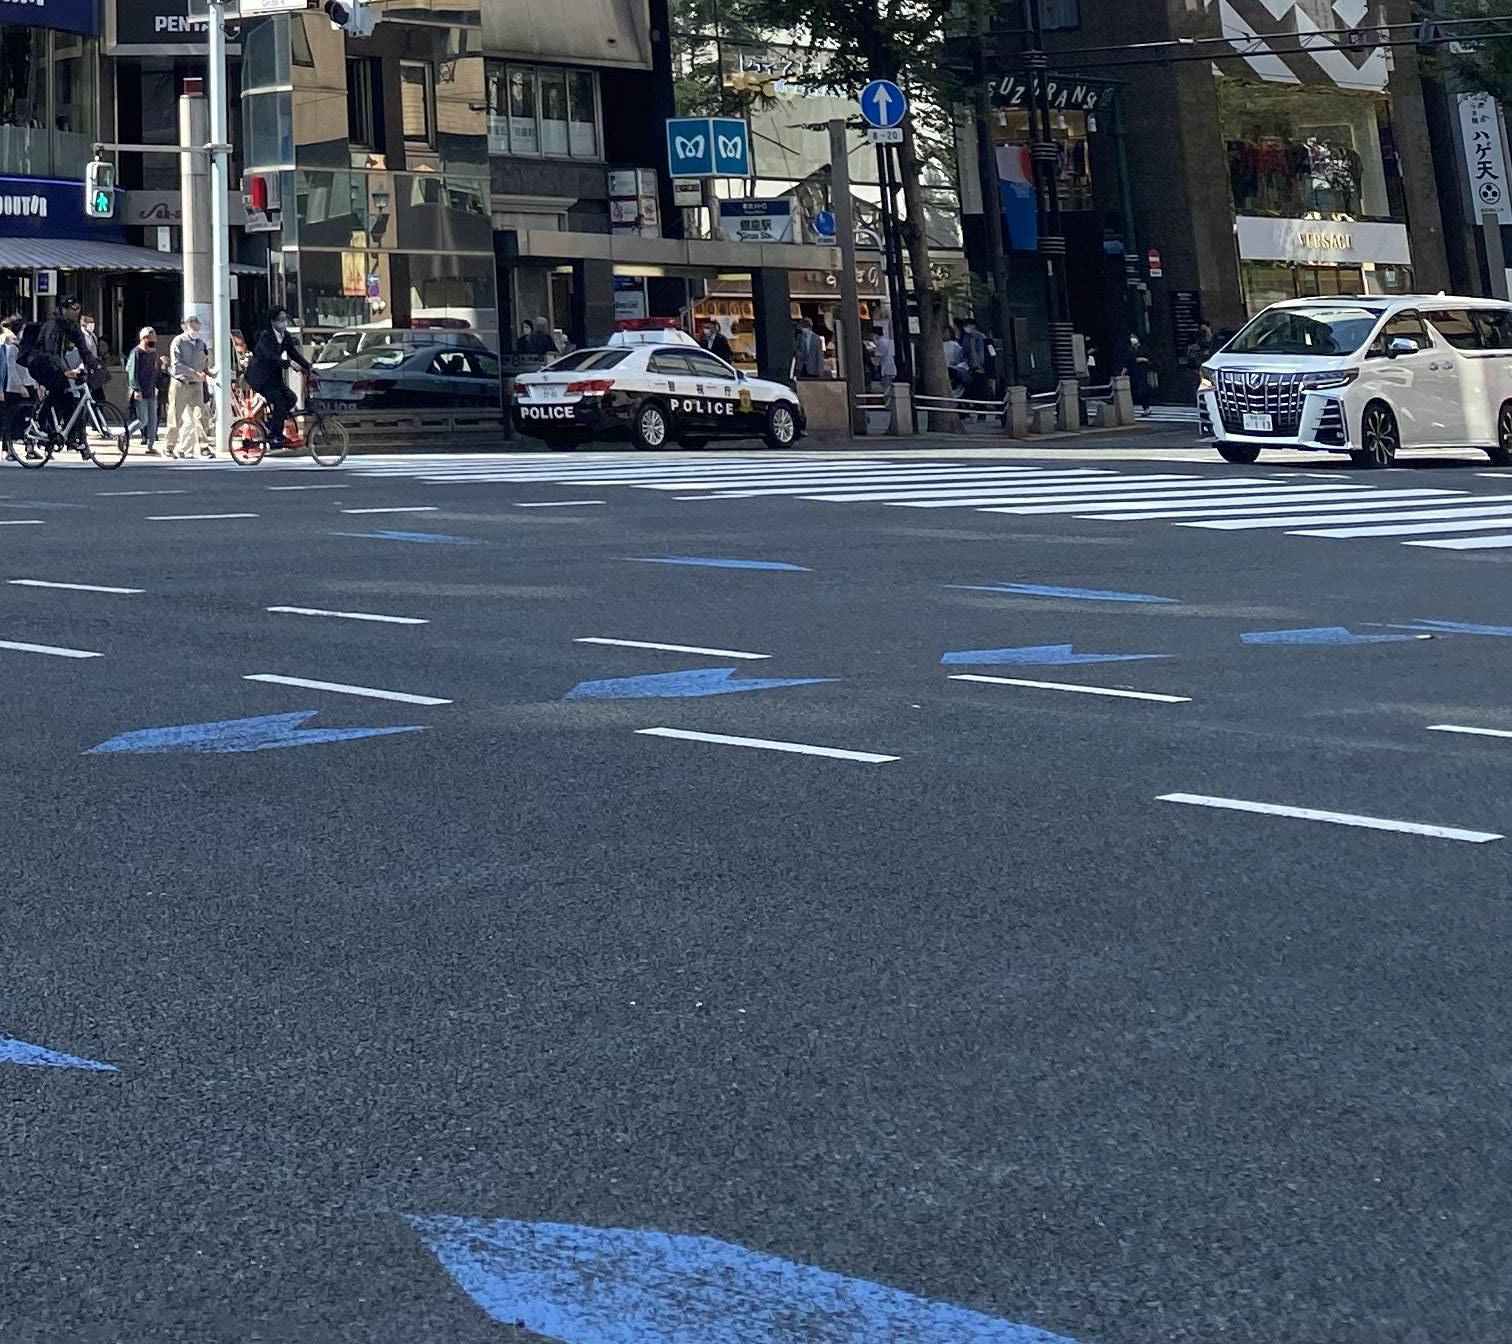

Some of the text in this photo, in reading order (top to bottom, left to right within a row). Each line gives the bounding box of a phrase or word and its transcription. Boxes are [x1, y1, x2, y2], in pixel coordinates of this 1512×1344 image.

[1297, 231, 1353, 250] VERSACE
[520, 405, 576, 420] POLICE
[670, 398, 734, 416] POLICE
